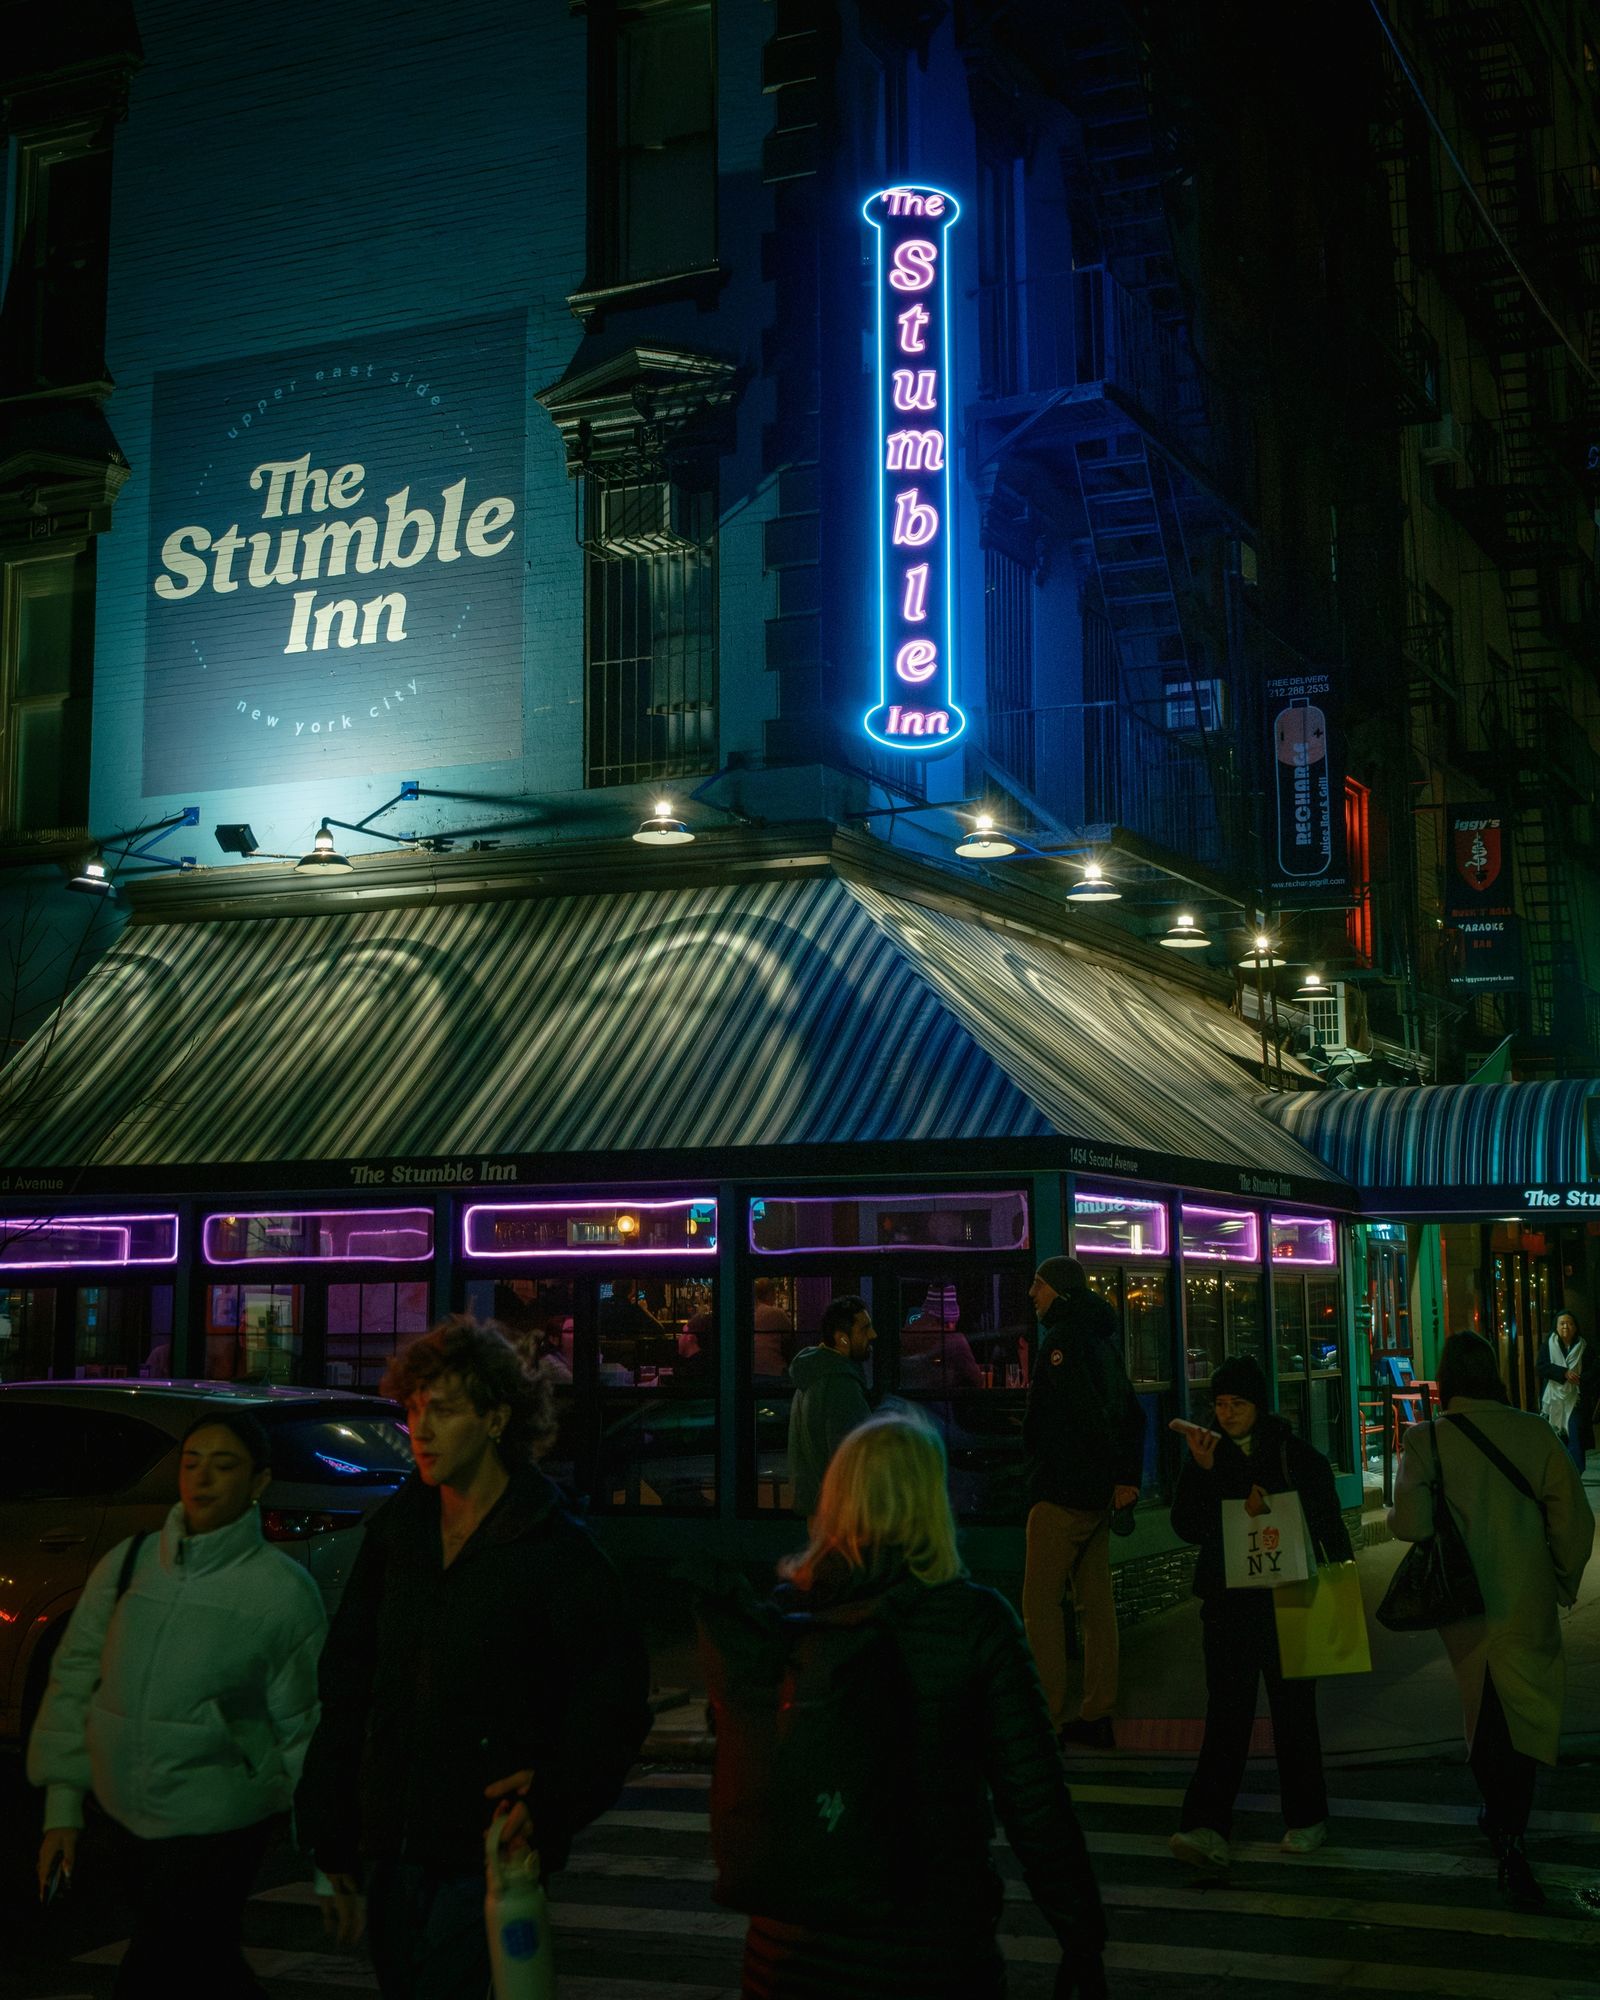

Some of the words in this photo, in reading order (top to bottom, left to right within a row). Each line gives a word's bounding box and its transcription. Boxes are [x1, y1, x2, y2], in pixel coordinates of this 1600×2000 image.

[881, 188, 945, 216] The
[228, 380, 297, 440] upper
[315, 363, 375, 381] east
[390, 371, 441, 407] side
[887, 239, 945, 683] Stumble
[249, 452, 366, 519] The
[154, 477, 516, 600] Stumble
[284, 590, 408, 655] Inn
[1289, 674, 1329, 685] DELIVERY
[236, 698, 280, 728] new
[295, 712, 353, 737] york
[369, 678, 419, 719] city
[886, 706, 950, 735] Inn
[1318, 776, 1329, 798] Grill
[350, 1165, 385, 1184] The
[391, 1161, 474, 1183] Stumble
[480, 1160, 518, 1182] Inn
[1070, 1147, 1088, 1164] 1454
[1089, 1149, 1114, 1168] Second
[1114, 1154, 1138, 1172] Avenue
[14, 1175, 64, 1190] Avenue
[1524, 1189, 1560, 1206] The
[1247, 1531, 1260, 1552] I
[1247, 1551, 1282, 1576] NY
